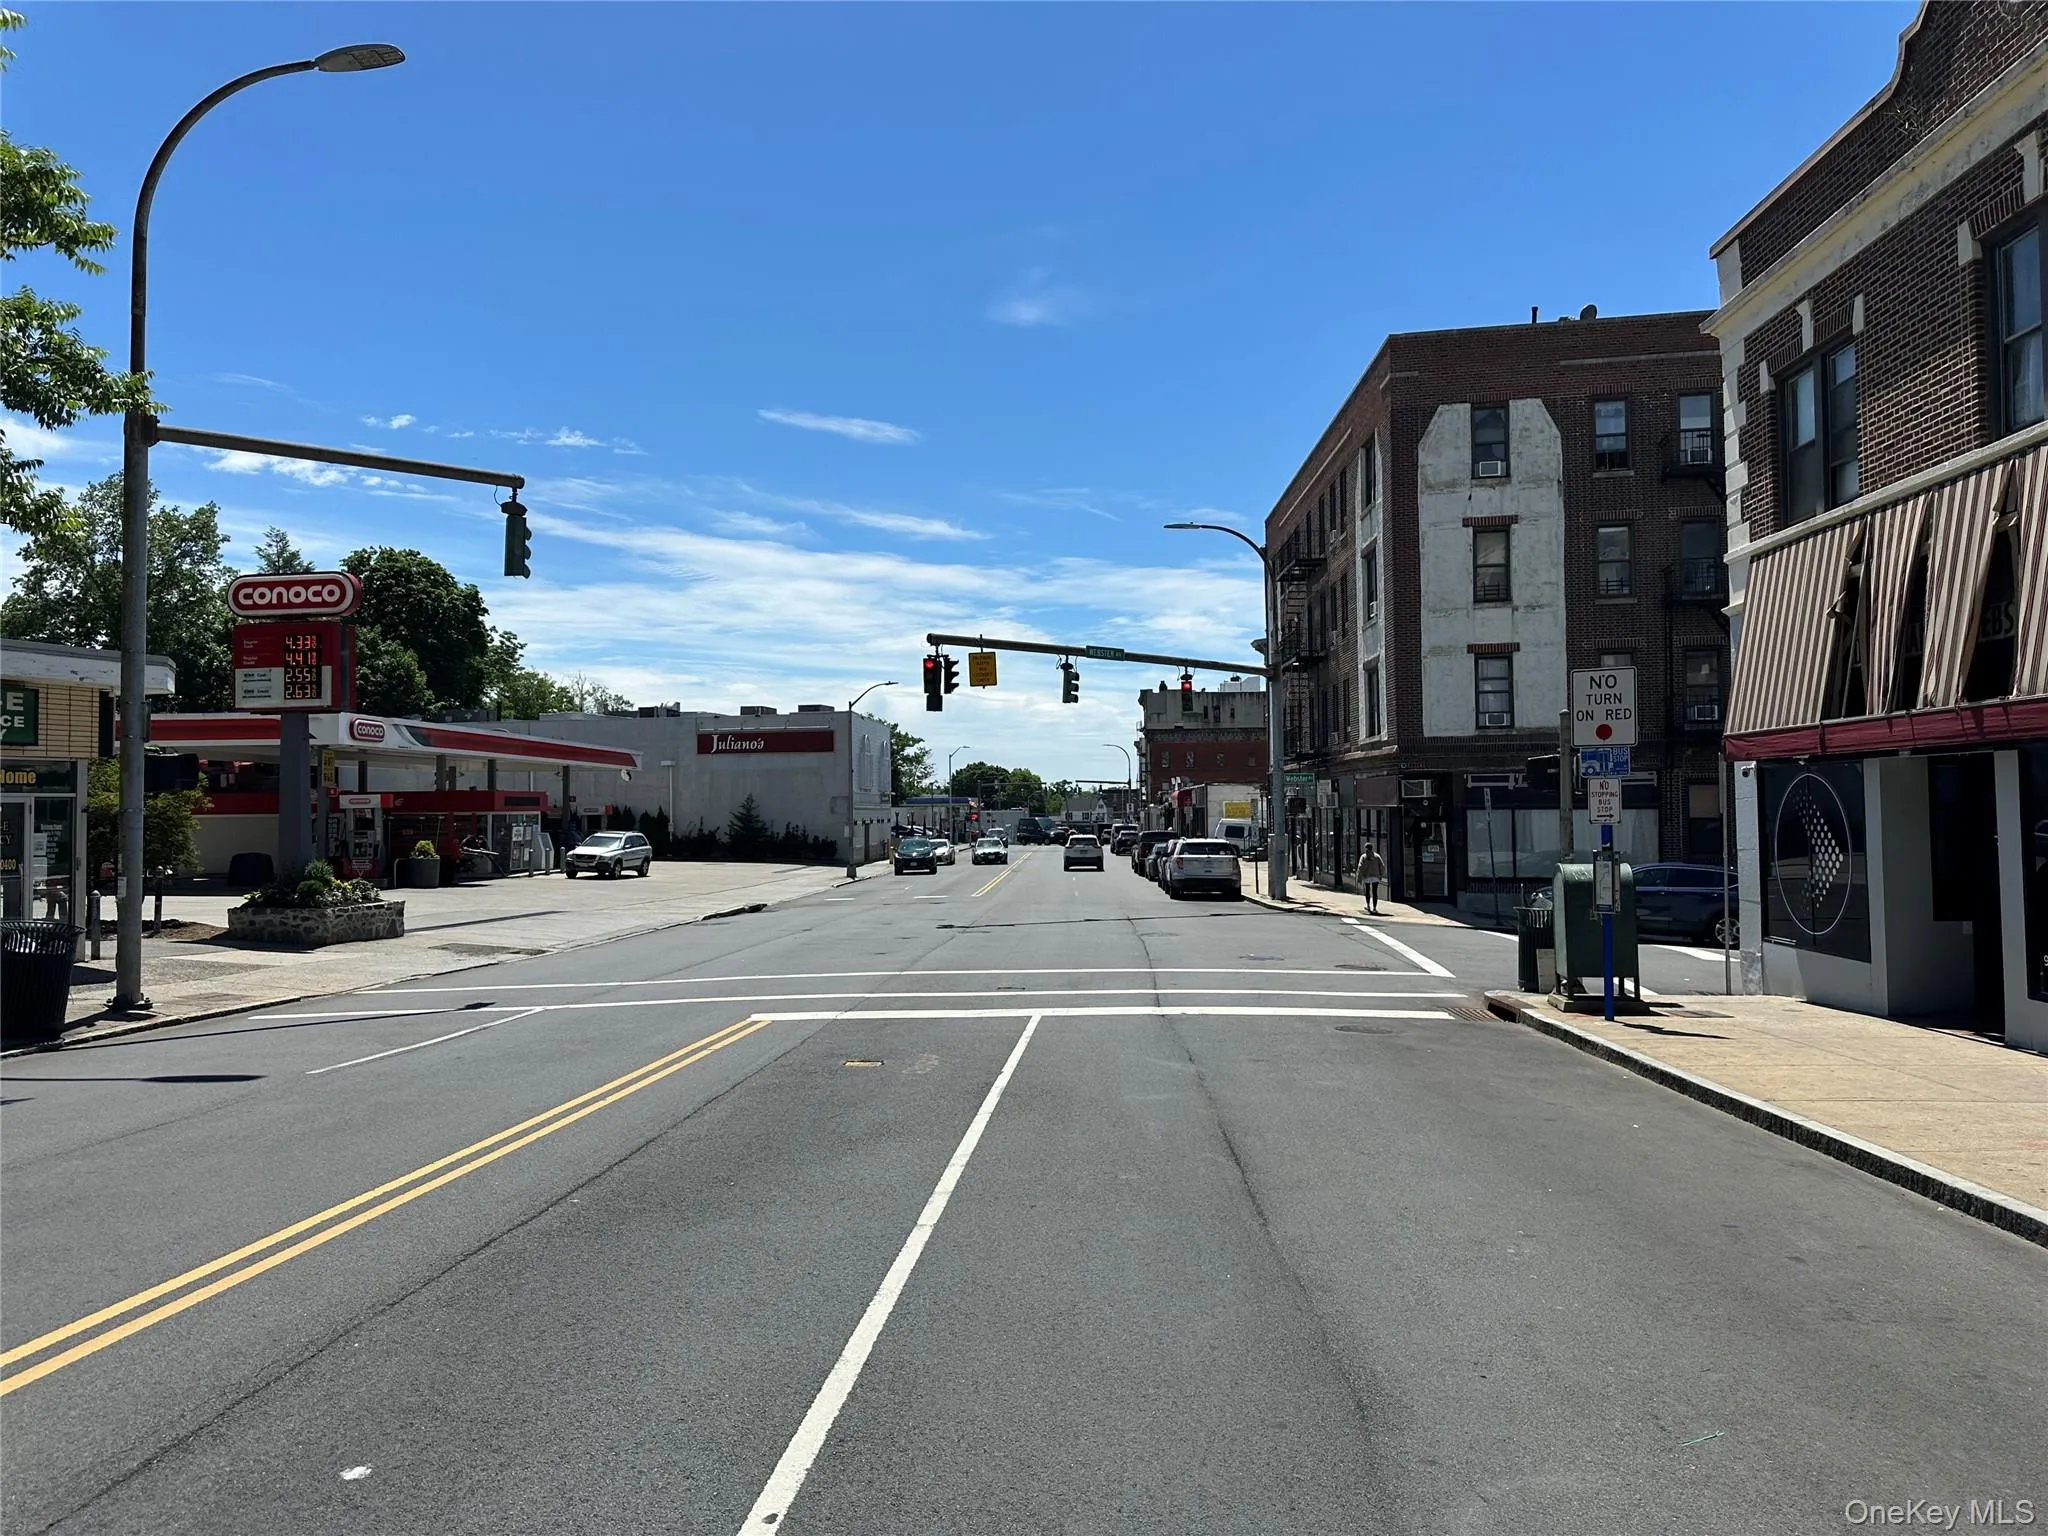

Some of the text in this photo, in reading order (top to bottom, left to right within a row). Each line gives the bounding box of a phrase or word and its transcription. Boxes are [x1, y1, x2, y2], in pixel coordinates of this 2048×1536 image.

[1088, 648, 1115, 658] WEBSTER
[1589, 674, 1617, 690] NO
[1586, 692, 1622, 706] TURN
[1576, 708, 1632, 722] ON RED
[711, 734, 765, 754] Juliano's
[1612, 747, 1628, 756] BUS
[1285, 775, 1308, 783] Webster
[1599, 781, 1610, 790] NO
[1598, 798, 1611, 806] BUS
